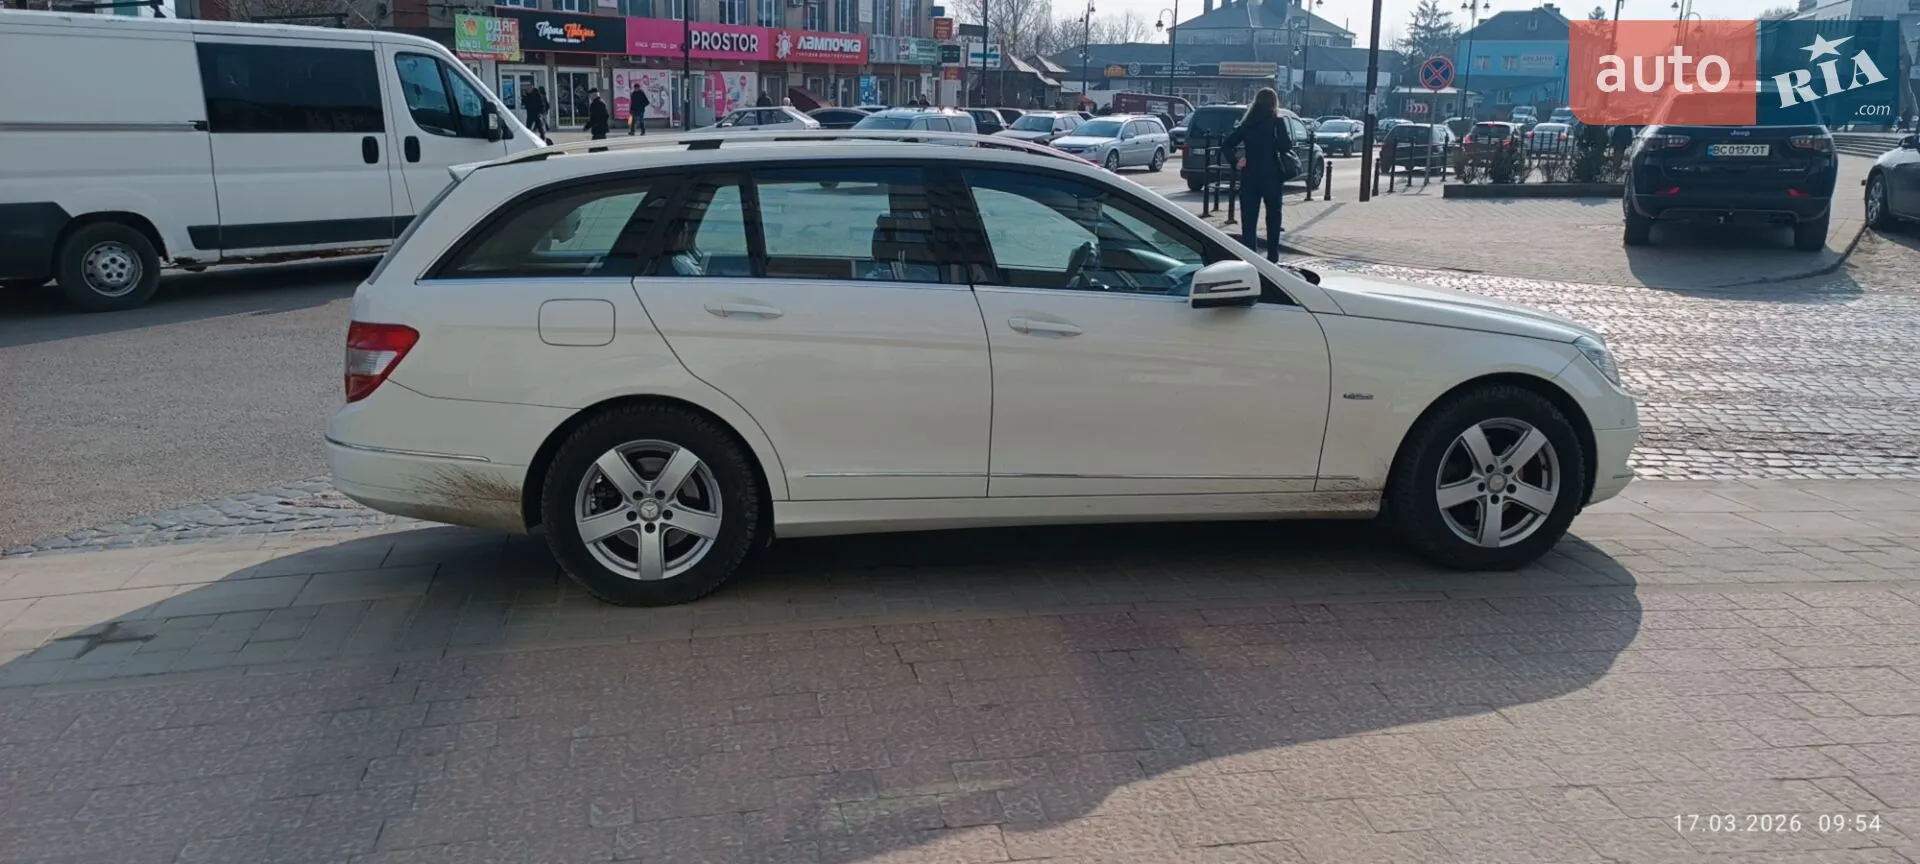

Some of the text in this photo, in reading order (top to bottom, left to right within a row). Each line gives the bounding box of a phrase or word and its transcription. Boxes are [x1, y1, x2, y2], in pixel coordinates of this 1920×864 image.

[691, 30, 759, 52] PROSTOR
[1714, 146, 1766, 154] BC 0157 OT
